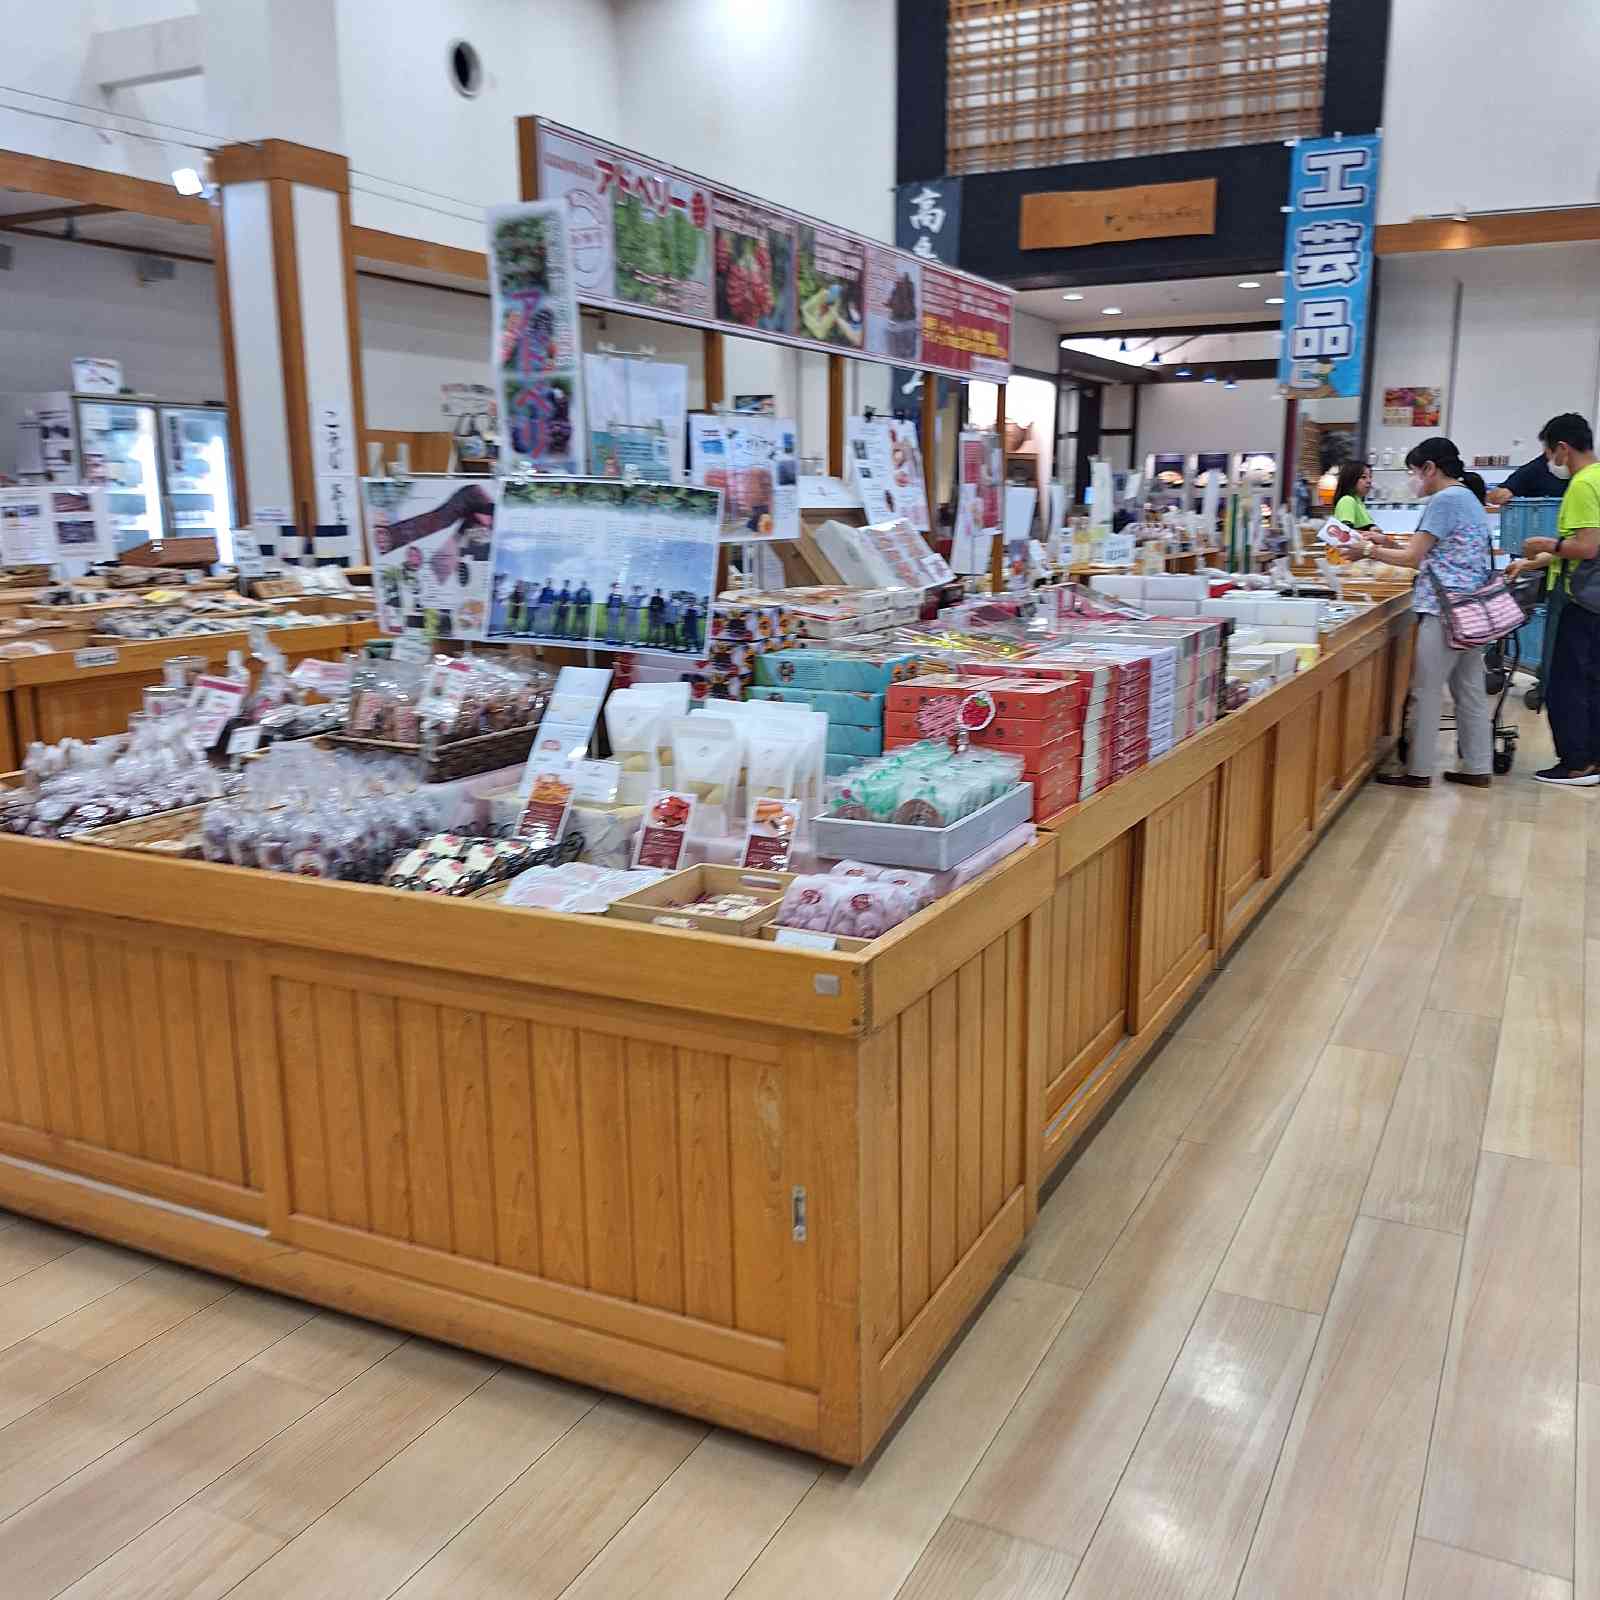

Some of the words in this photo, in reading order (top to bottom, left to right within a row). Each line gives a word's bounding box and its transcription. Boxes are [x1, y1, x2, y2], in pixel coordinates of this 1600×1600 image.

[593, 158, 688, 218] アドベリー
[1290, 149, 1368, 361] 工芸品
